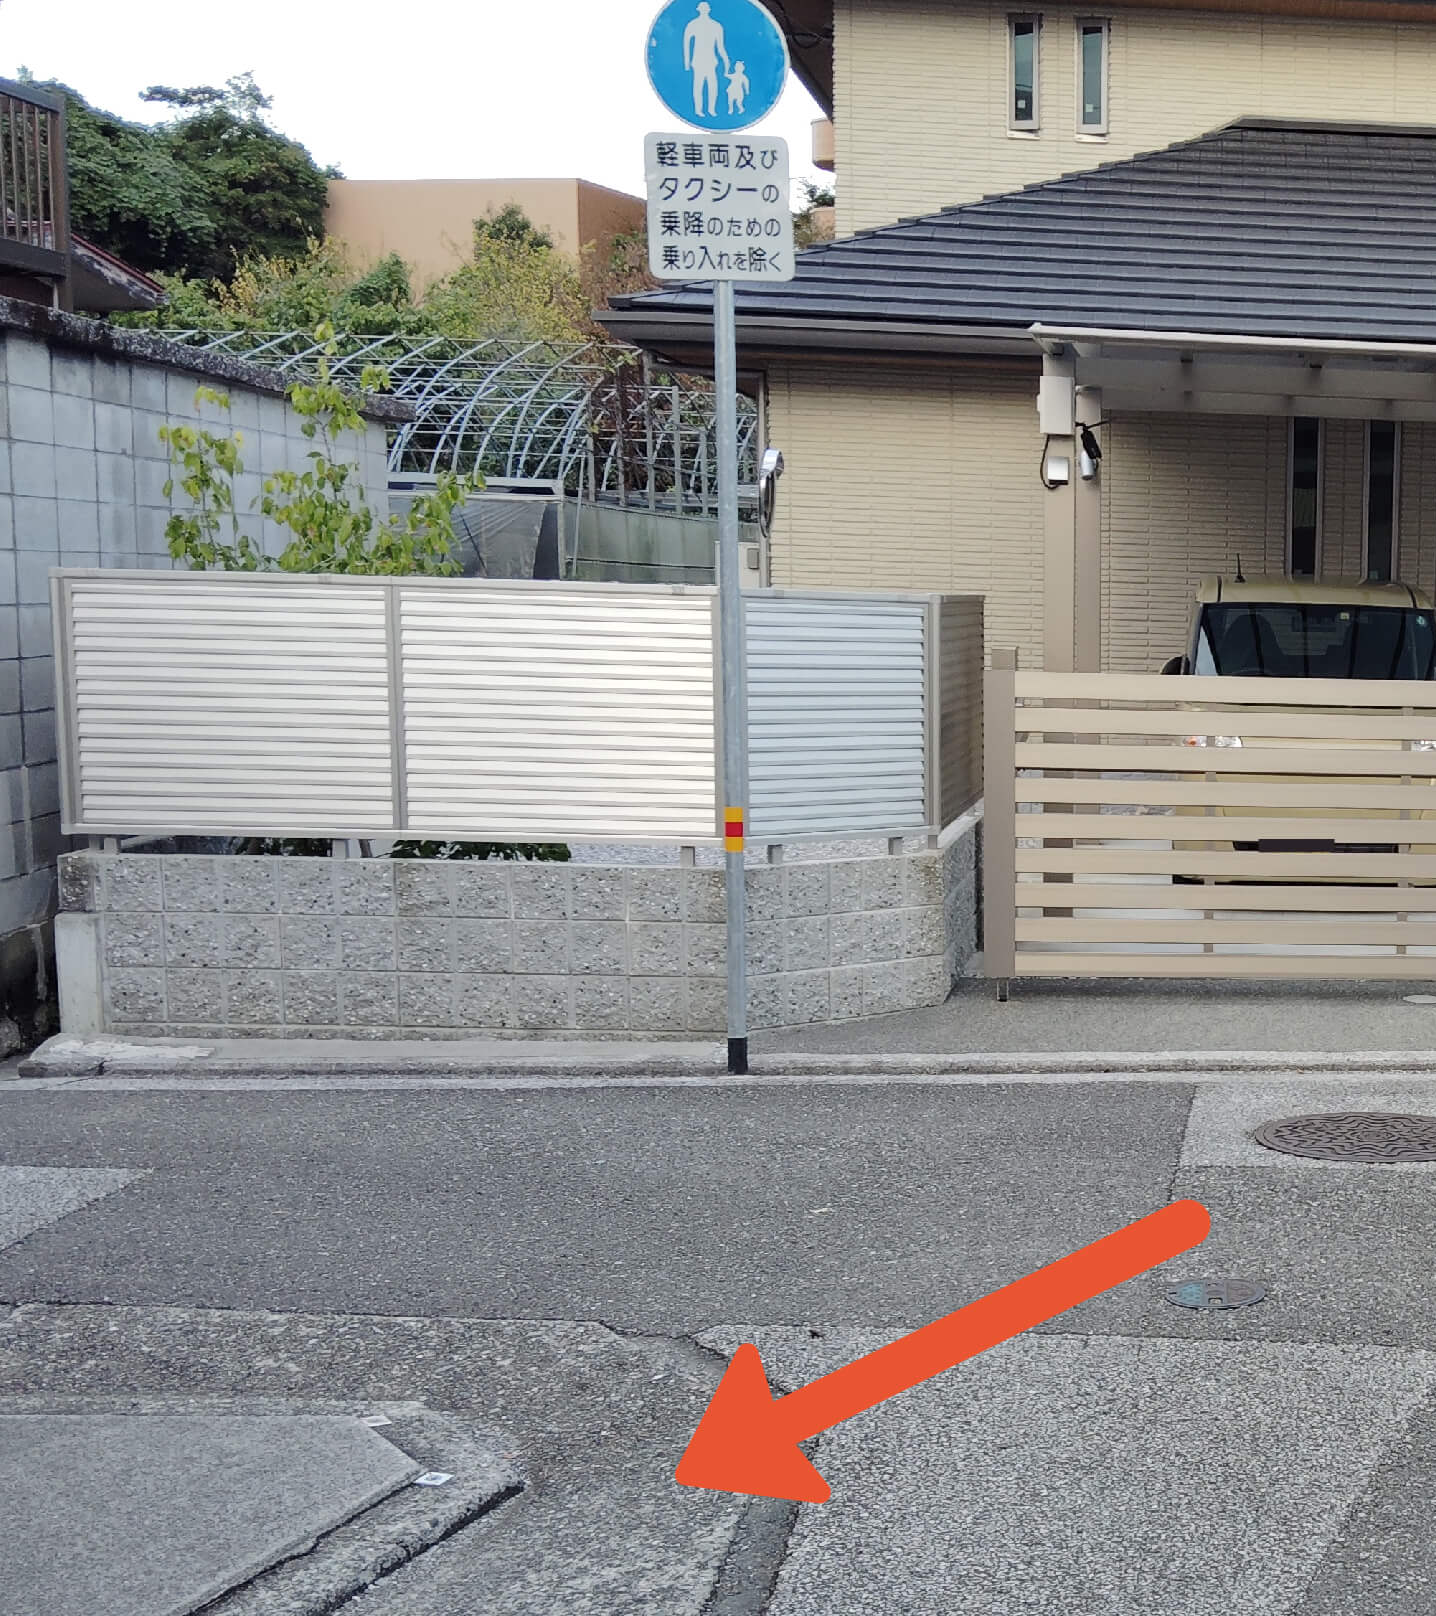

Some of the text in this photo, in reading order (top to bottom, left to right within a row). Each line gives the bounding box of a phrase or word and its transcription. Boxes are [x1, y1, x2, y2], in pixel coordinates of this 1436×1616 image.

[656, 141, 777, 170] 軽車両及び
[659, 177, 780, 203] タクシーの
[660, 210, 781, 237] 乗降のための
[662, 244, 783, 273] 乗り入れを除く
